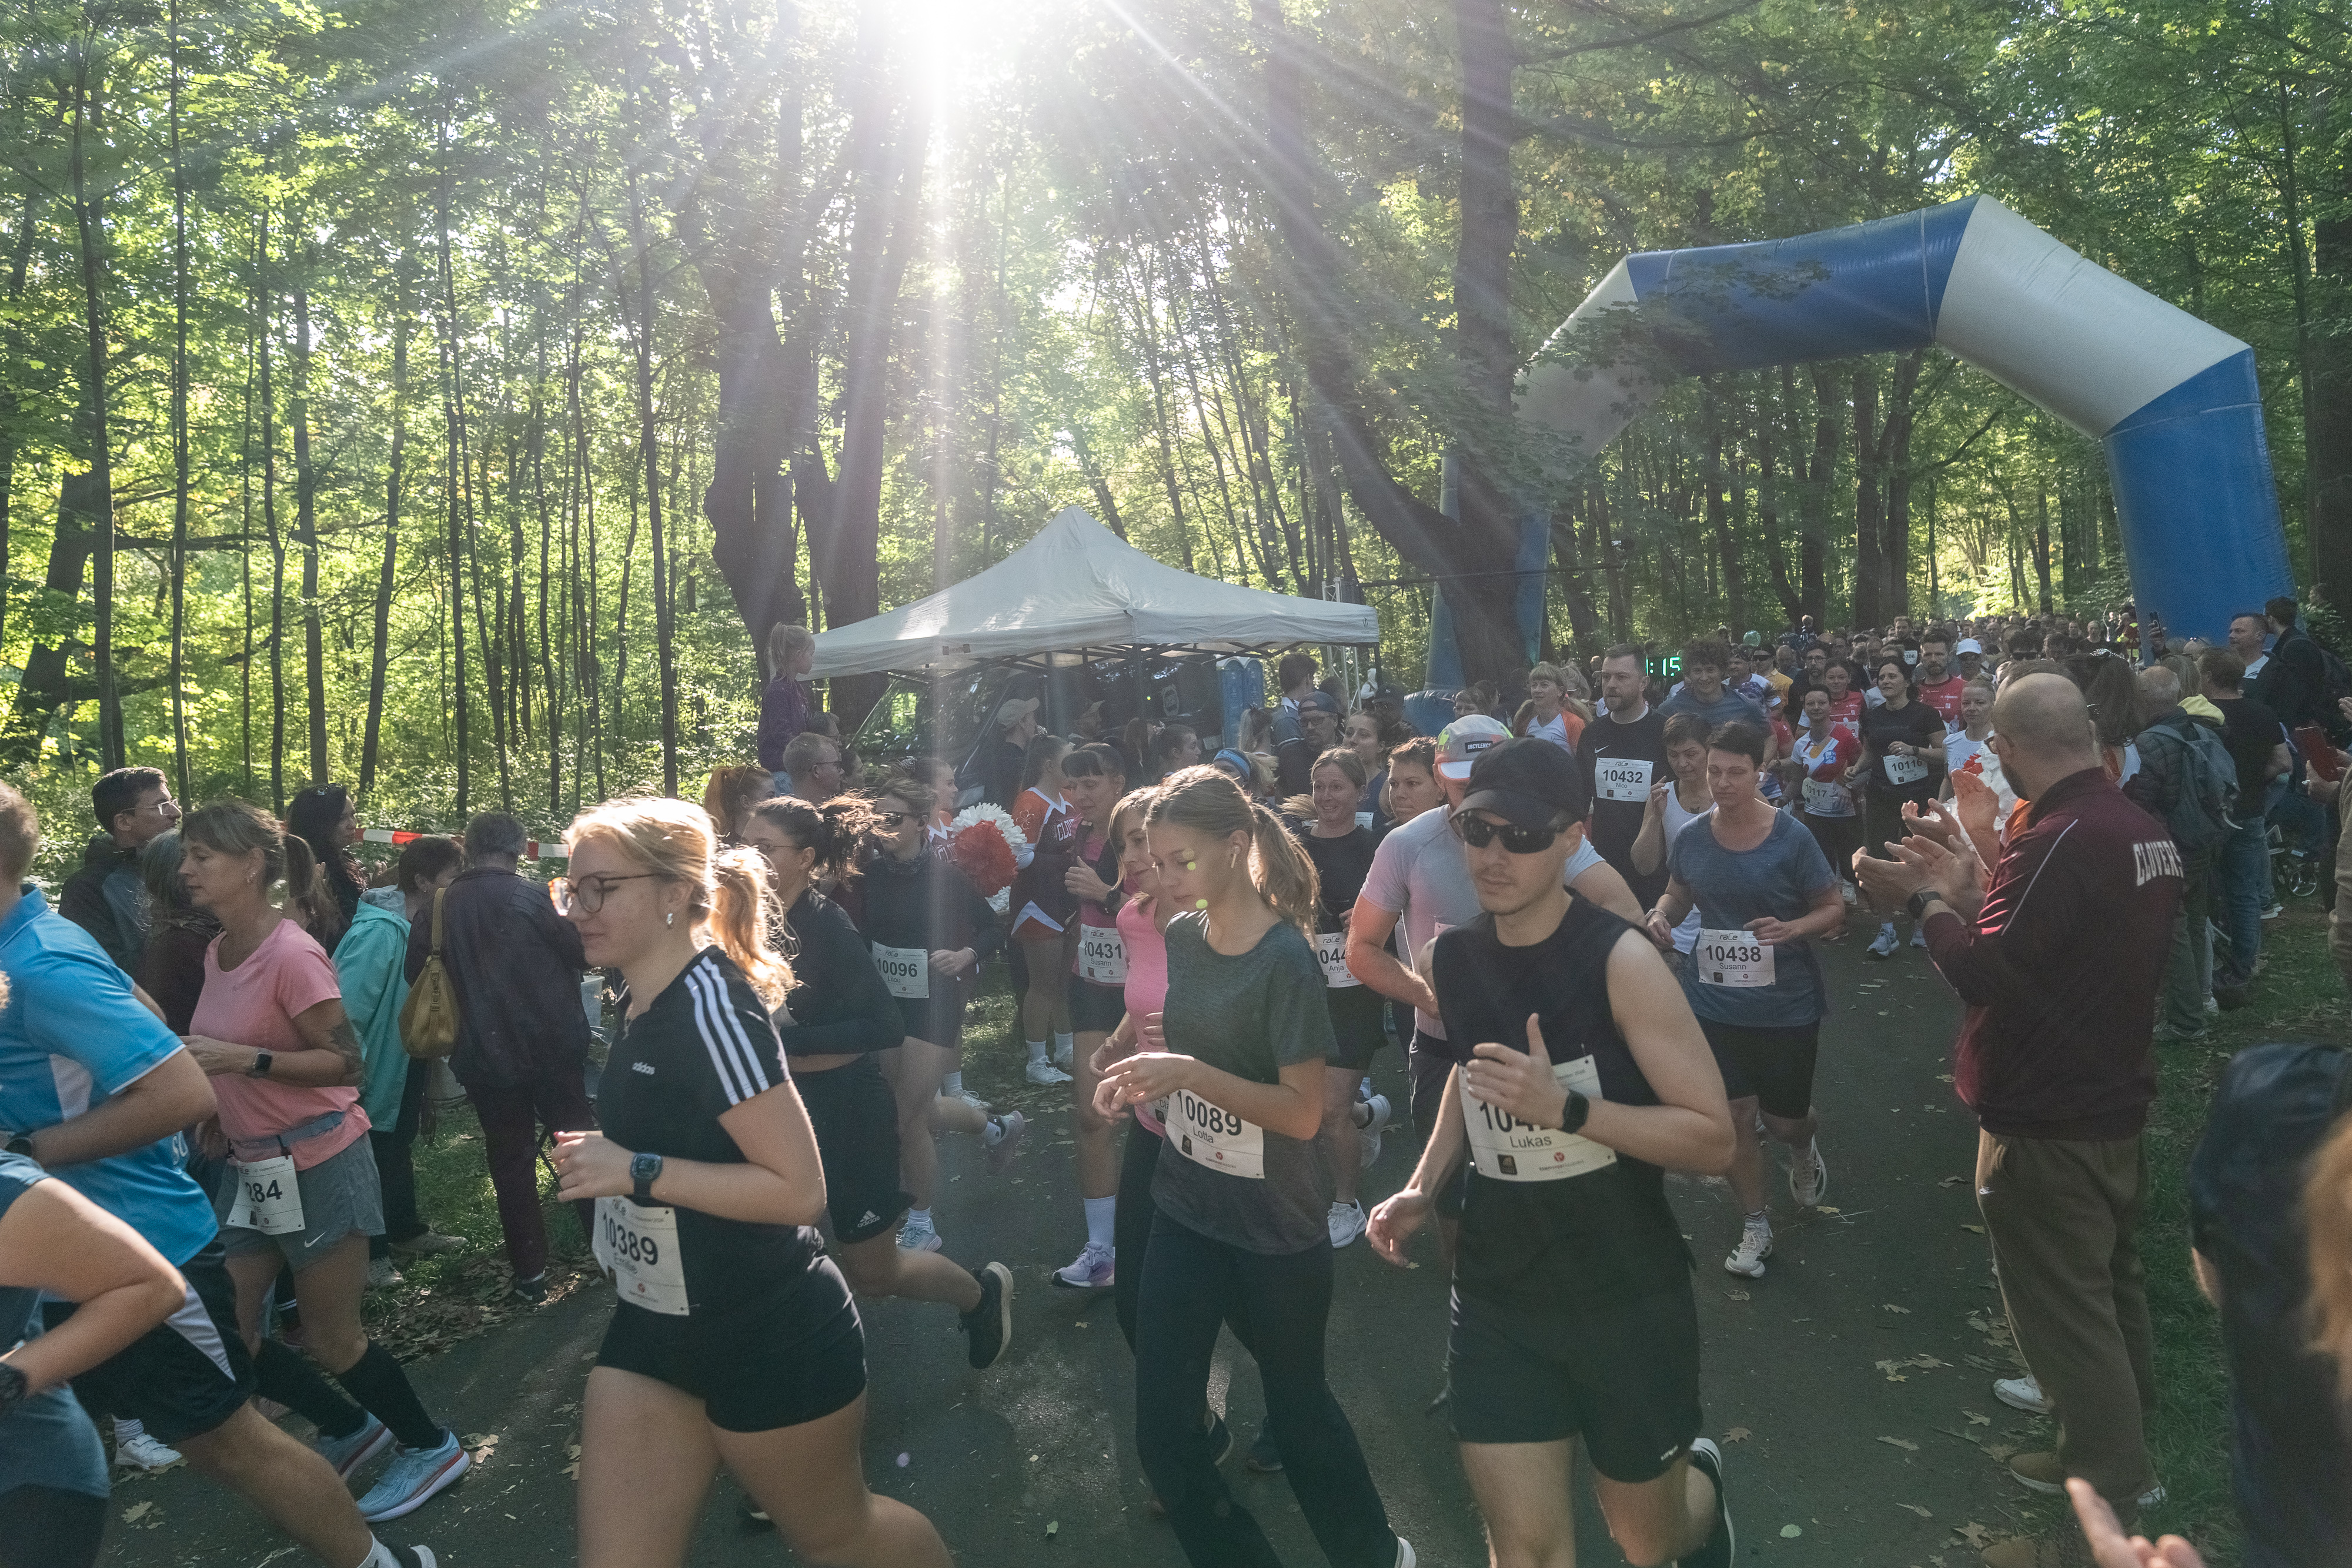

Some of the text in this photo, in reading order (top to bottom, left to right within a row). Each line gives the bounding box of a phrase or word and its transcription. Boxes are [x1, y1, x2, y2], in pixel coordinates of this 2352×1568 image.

[1603, 769, 1643, 783] 10432
[1806, 784, 1827, 798] 10117
[1084, 941, 1122, 959] 10431
[1705, 945, 1762, 962] 10438
[877, 958, 918, 978] 10096
[1091, 958, 1111, 966] Susann
[1177, 1090, 1242, 1136] 10089
[1192, 1125, 1214, 1144] Lotta
[1509, 1135, 1552, 1148] Lukas
[857, 1215, 880, 1228] adidas
[603, 1211, 658, 1265] 10389
